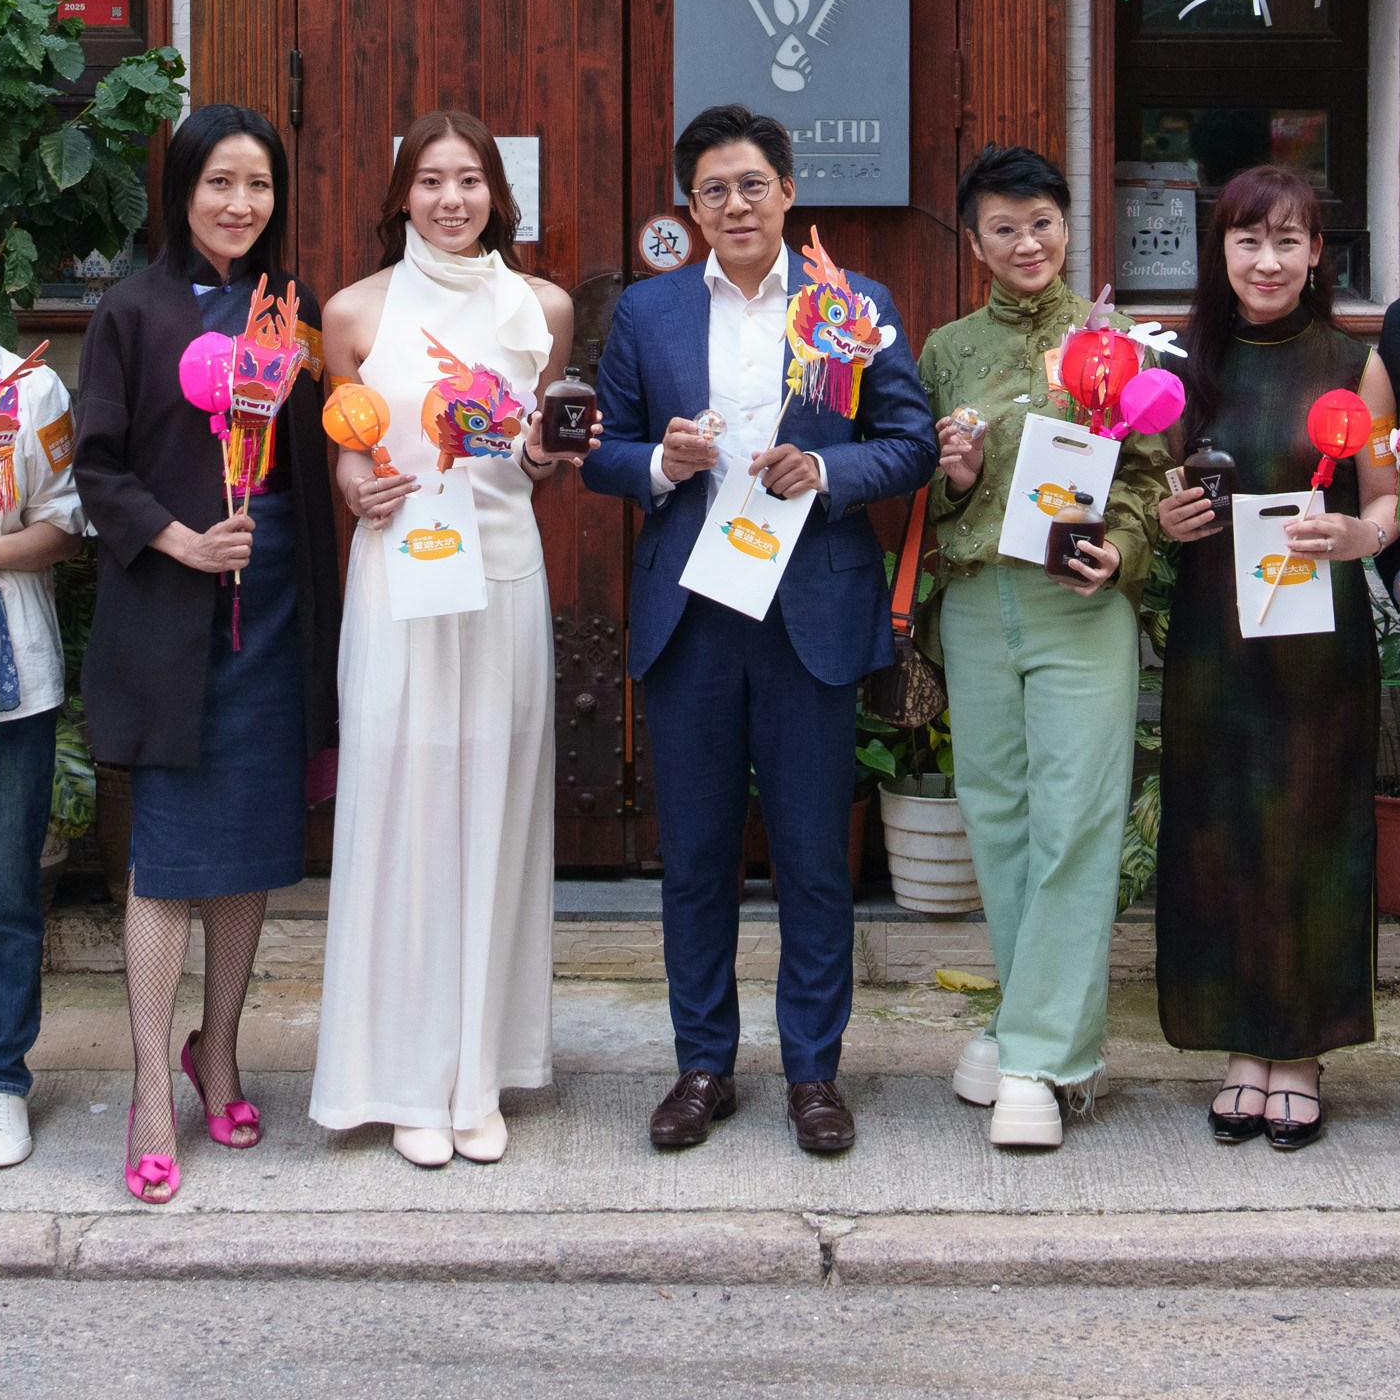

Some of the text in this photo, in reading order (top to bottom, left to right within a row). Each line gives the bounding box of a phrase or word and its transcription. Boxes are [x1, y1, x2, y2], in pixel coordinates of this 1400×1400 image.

[64, 3, 86, 11] 2025
[1145, 216, 1164, 230] 16
[648, 226, 682, 257] 拉
